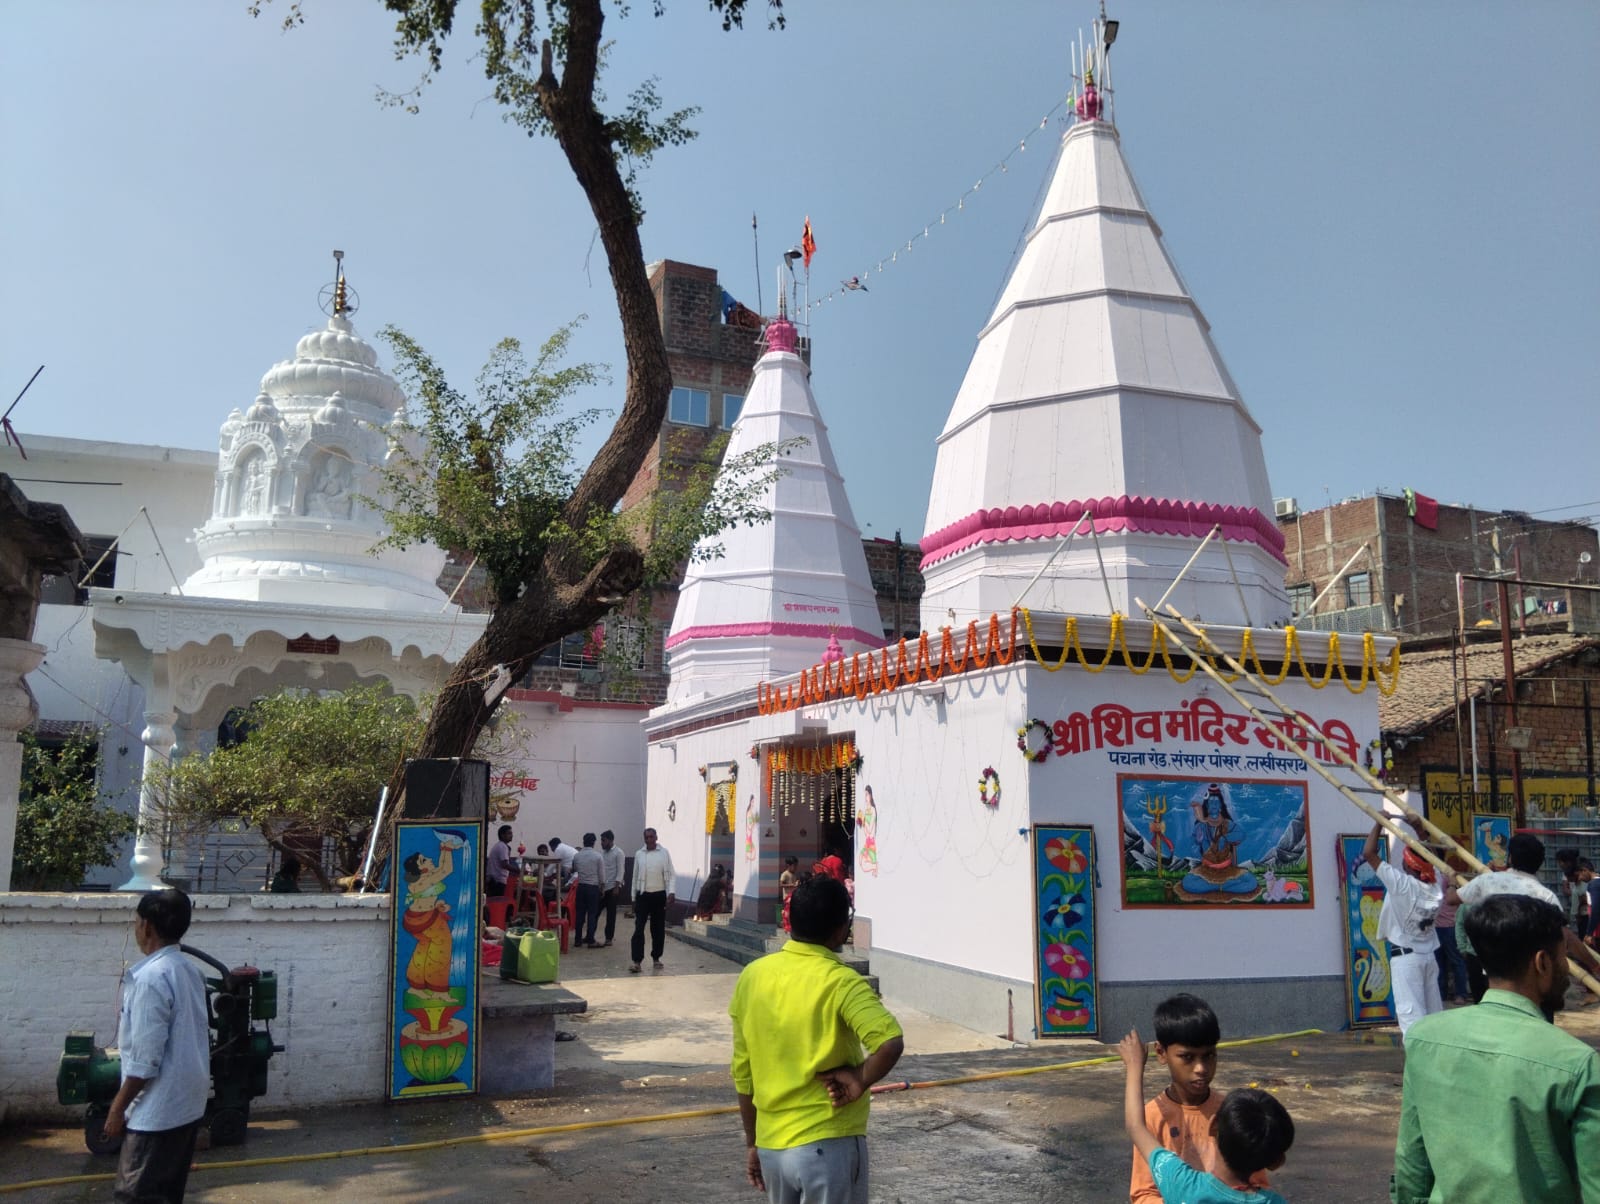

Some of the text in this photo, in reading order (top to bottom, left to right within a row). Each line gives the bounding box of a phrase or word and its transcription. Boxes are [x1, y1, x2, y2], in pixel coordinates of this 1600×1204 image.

[1053, 711, 1091, 757] श्री
[1091, 703, 1162, 748] शिव
[1164, 697, 1250, 746] मंदिर
[1107, 751, 1146, 766] पचना
[1170, 749, 1208, 771] संसार
